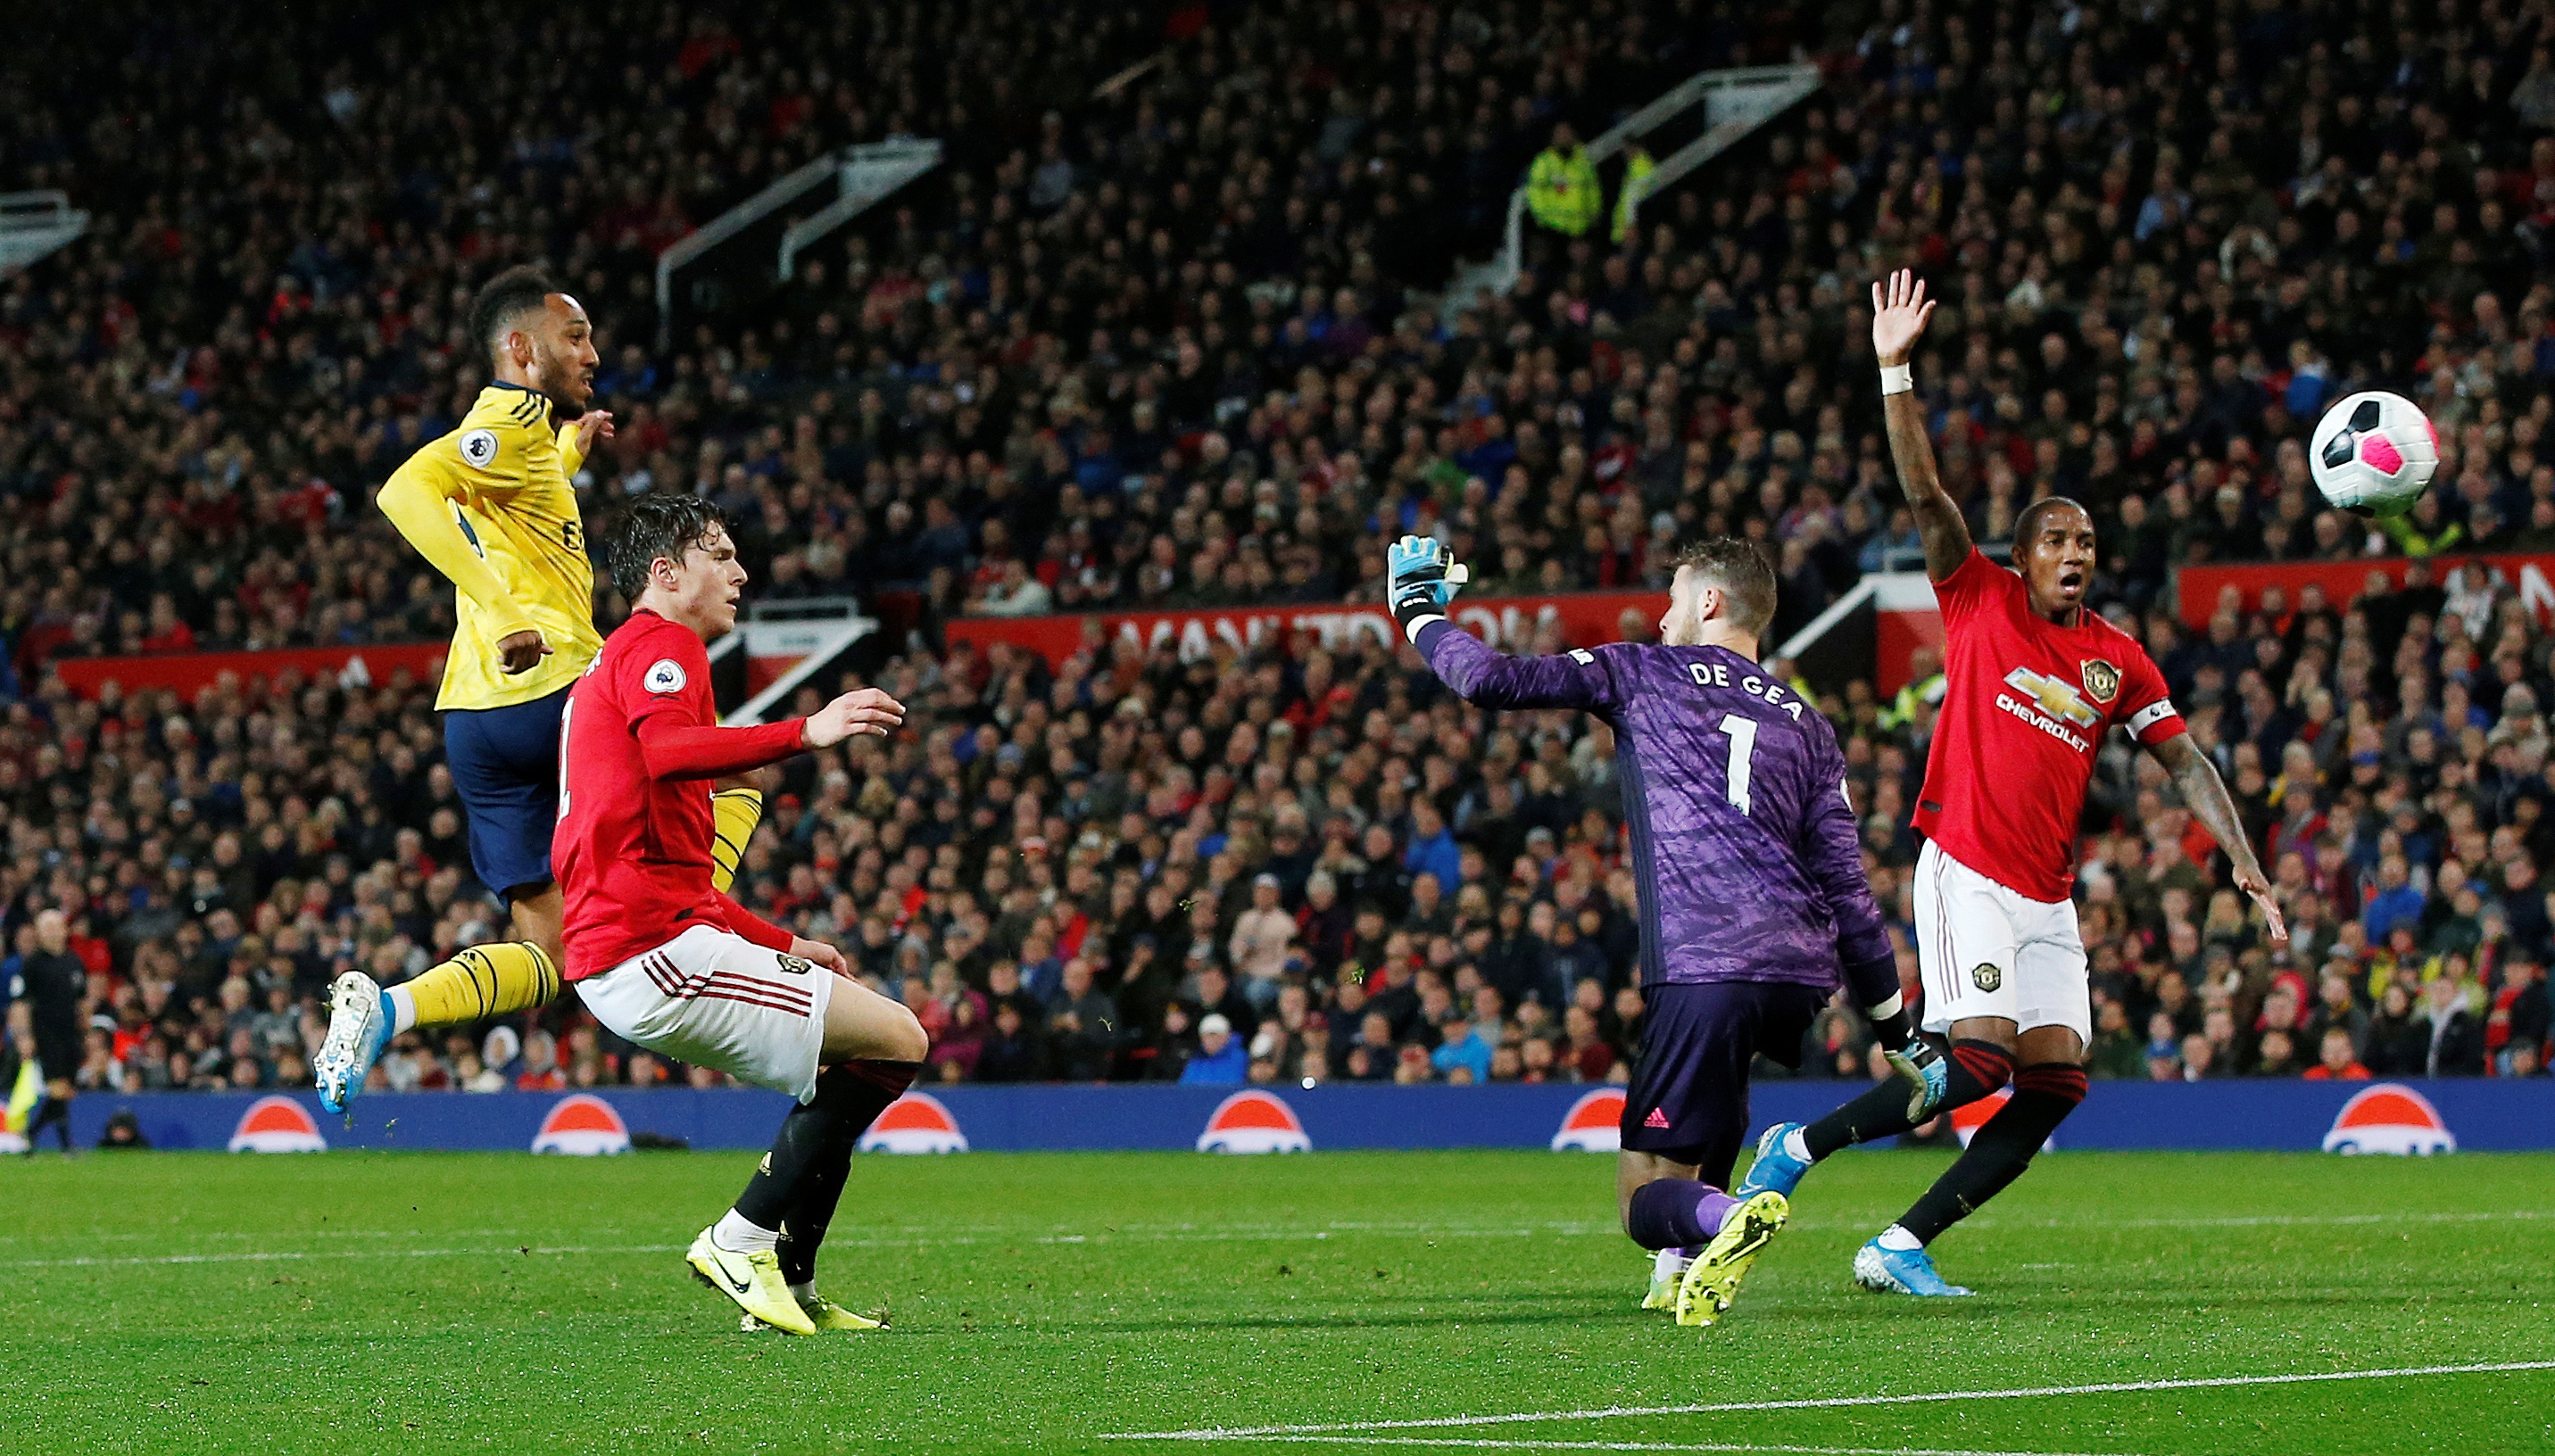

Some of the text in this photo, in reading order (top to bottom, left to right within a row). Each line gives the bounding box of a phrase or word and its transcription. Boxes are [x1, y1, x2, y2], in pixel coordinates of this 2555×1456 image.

[1688, 663, 1804, 722] DE GEA
[1995, 693, 2089, 752] CHEVROLET
[1718, 713, 1758, 816] 1
